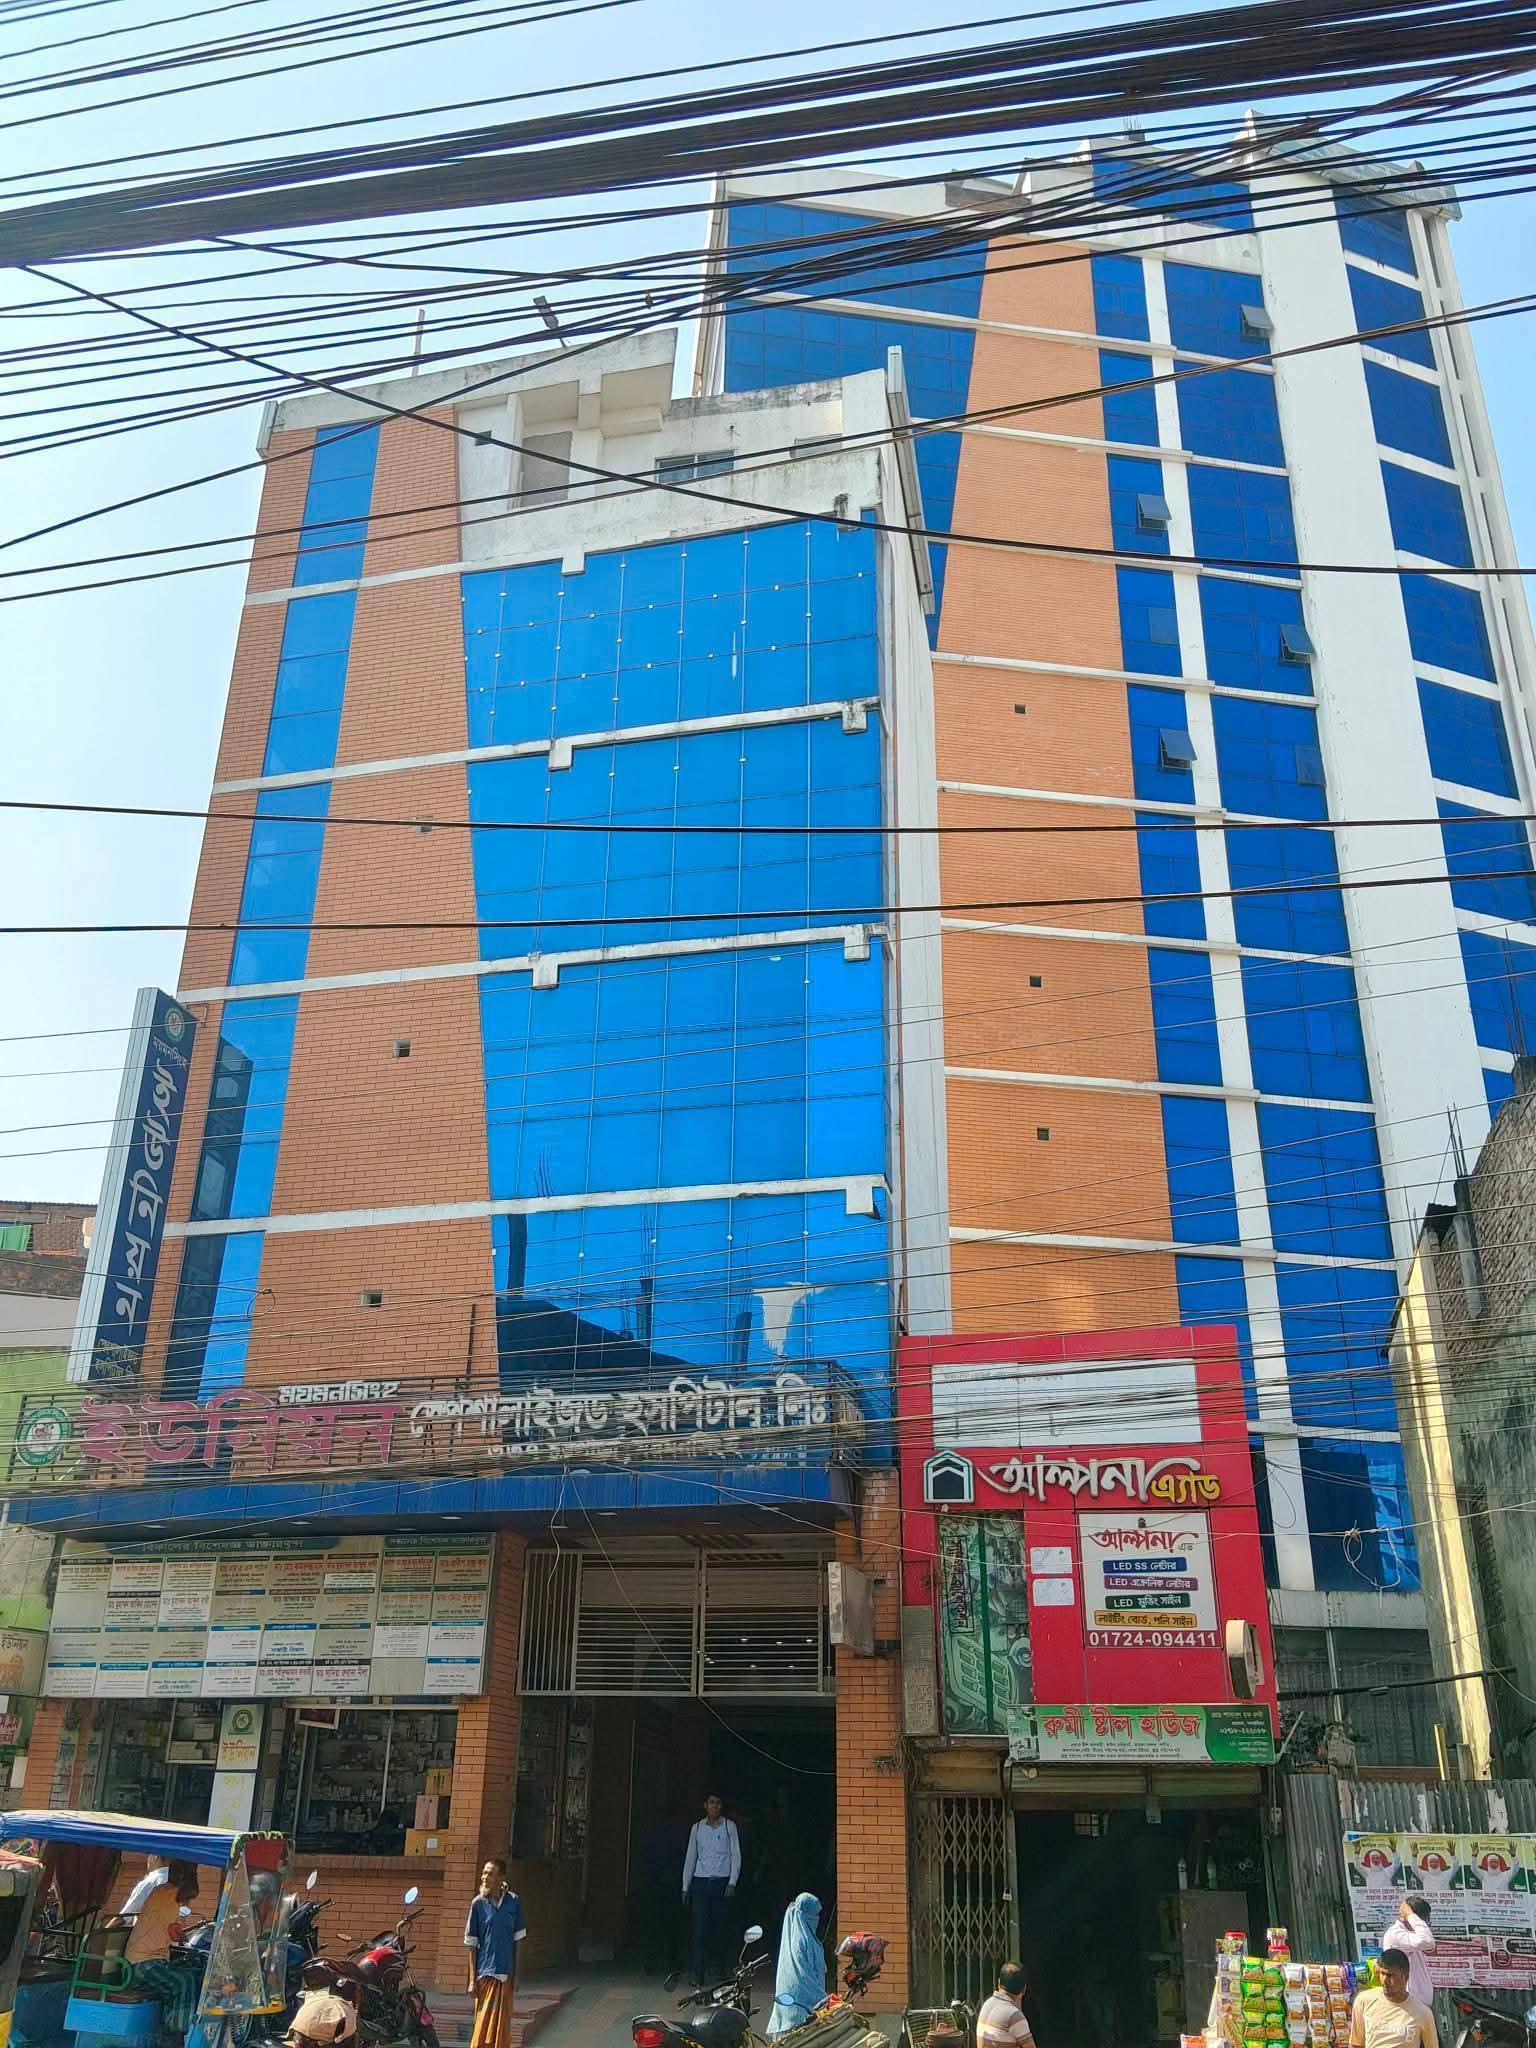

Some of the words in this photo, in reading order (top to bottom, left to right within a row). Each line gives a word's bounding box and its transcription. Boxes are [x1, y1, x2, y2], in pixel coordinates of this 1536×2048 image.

[114, 1057, 180, 1337] ইউনিয়ন
[279, 1380, 400, 1404] ময়মনসিংহ
[81, 1389, 402, 1472] ইউনিয়ন
[976, 1454, 1202, 1504] আল্পনা
[1089, 1528, 1200, 1553] আল্পনা
[1113, 1562, 1132, 1571] LED
[1134, 1562, 1148, 1571] SS
[1150, 1560, 1177, 1571] লেটার
[1109, 1577, 1128, 1586] LED
[1165, 1578, 1192, 1589] লেটার
[1113, 1598, 1134, 1607] LED
[1160, 1595, 1182, 1606] সাইন
[1171, 1616, 1193, 1626] সাইন
[1089, 1632, 1217, 1647] 01724-094411
[1041, 1706, 1088, 1739] রুমী
[1138, 1709, 1203, 1740] হাউজ
